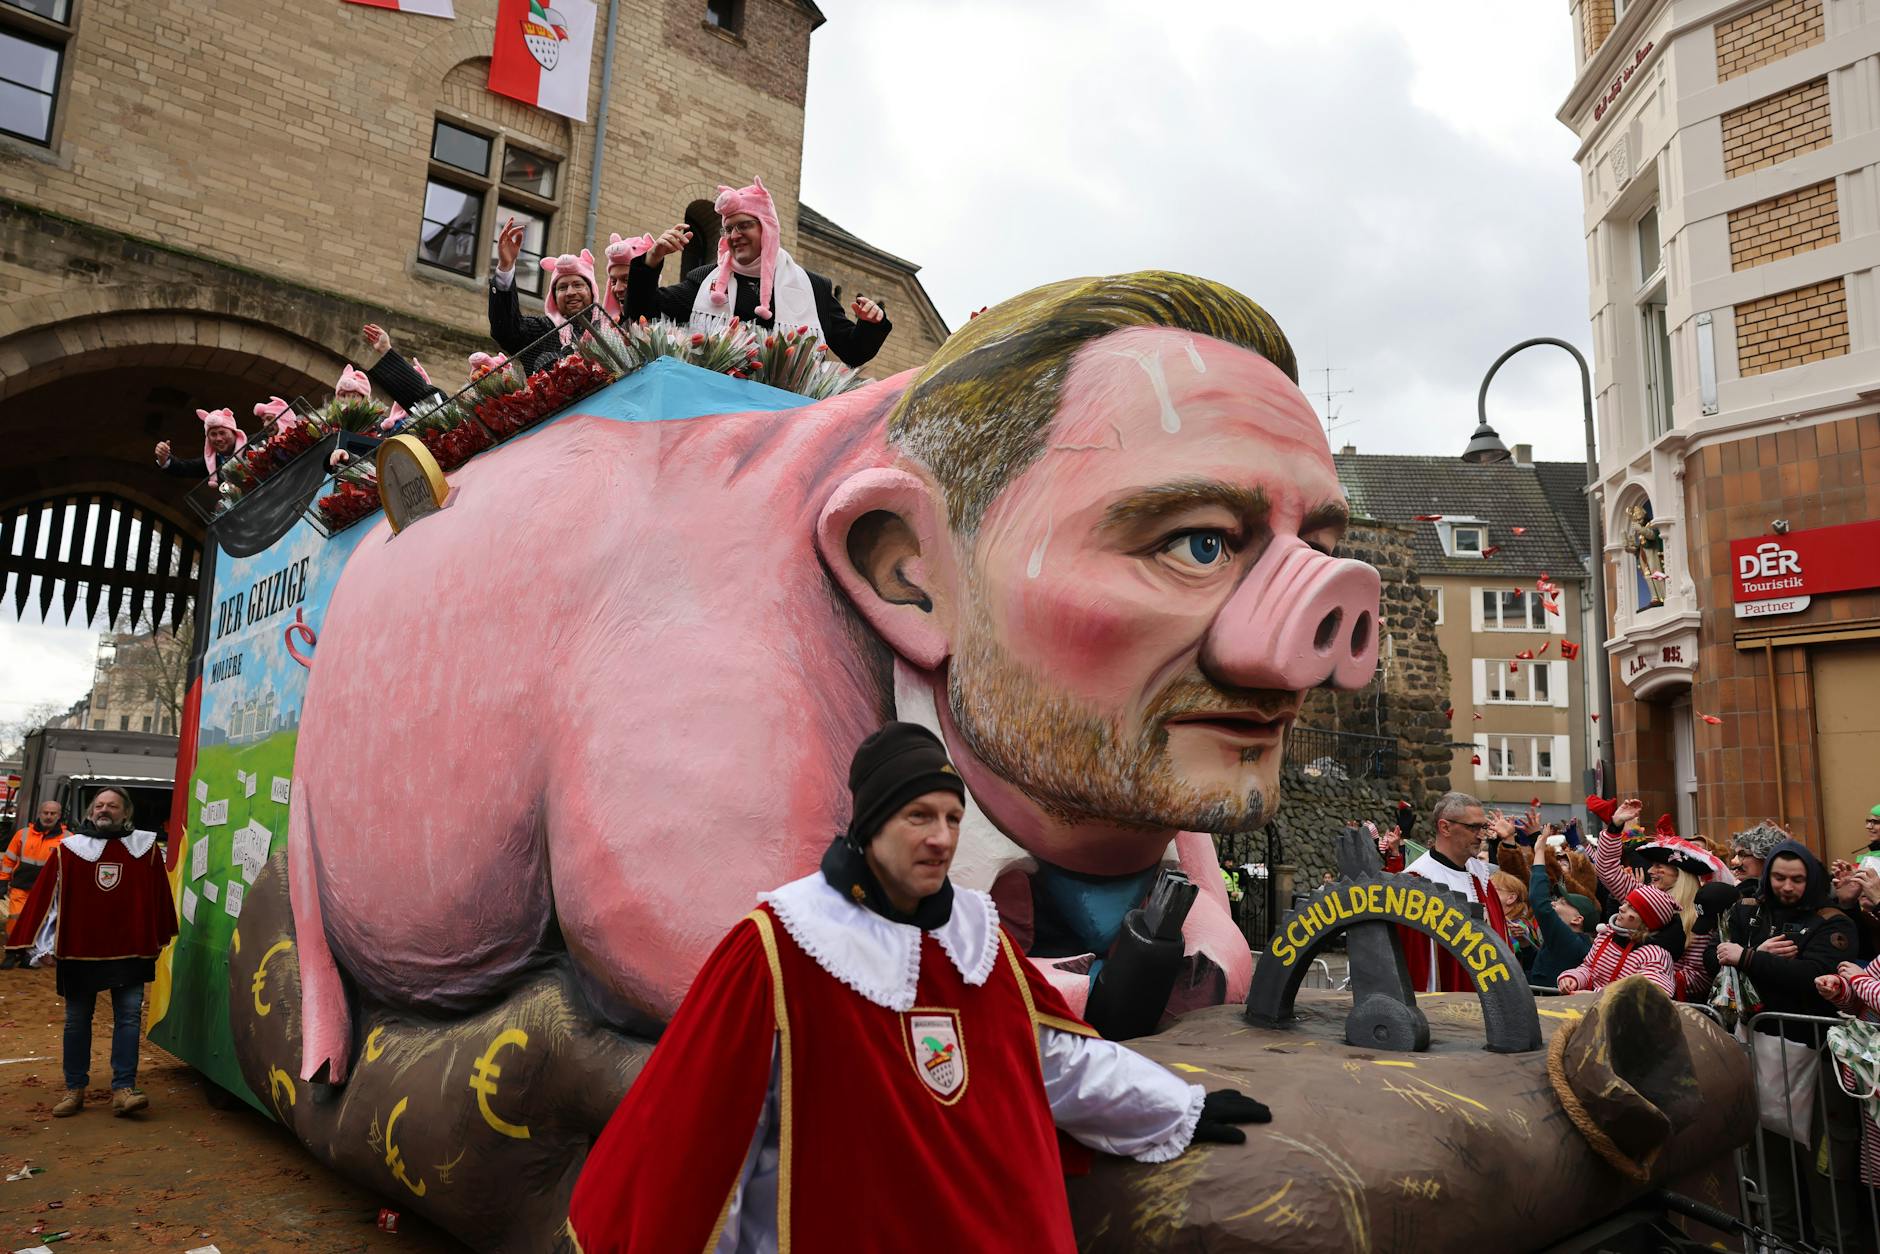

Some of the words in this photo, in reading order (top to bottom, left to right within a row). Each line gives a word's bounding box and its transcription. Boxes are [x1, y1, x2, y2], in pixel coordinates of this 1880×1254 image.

[1739, 548, 1802, 580] DER
[1742, 576, 1804, 593] Touristik
[216, 592, 244, 640] DER
[247, 556, 310, 626] GEIZIGE
[1744, 600, 1795, 615] Partner
[1271, 884, 1511, 993] SCHULDENBREMSE
[469, 1028, 531, 1139] €
